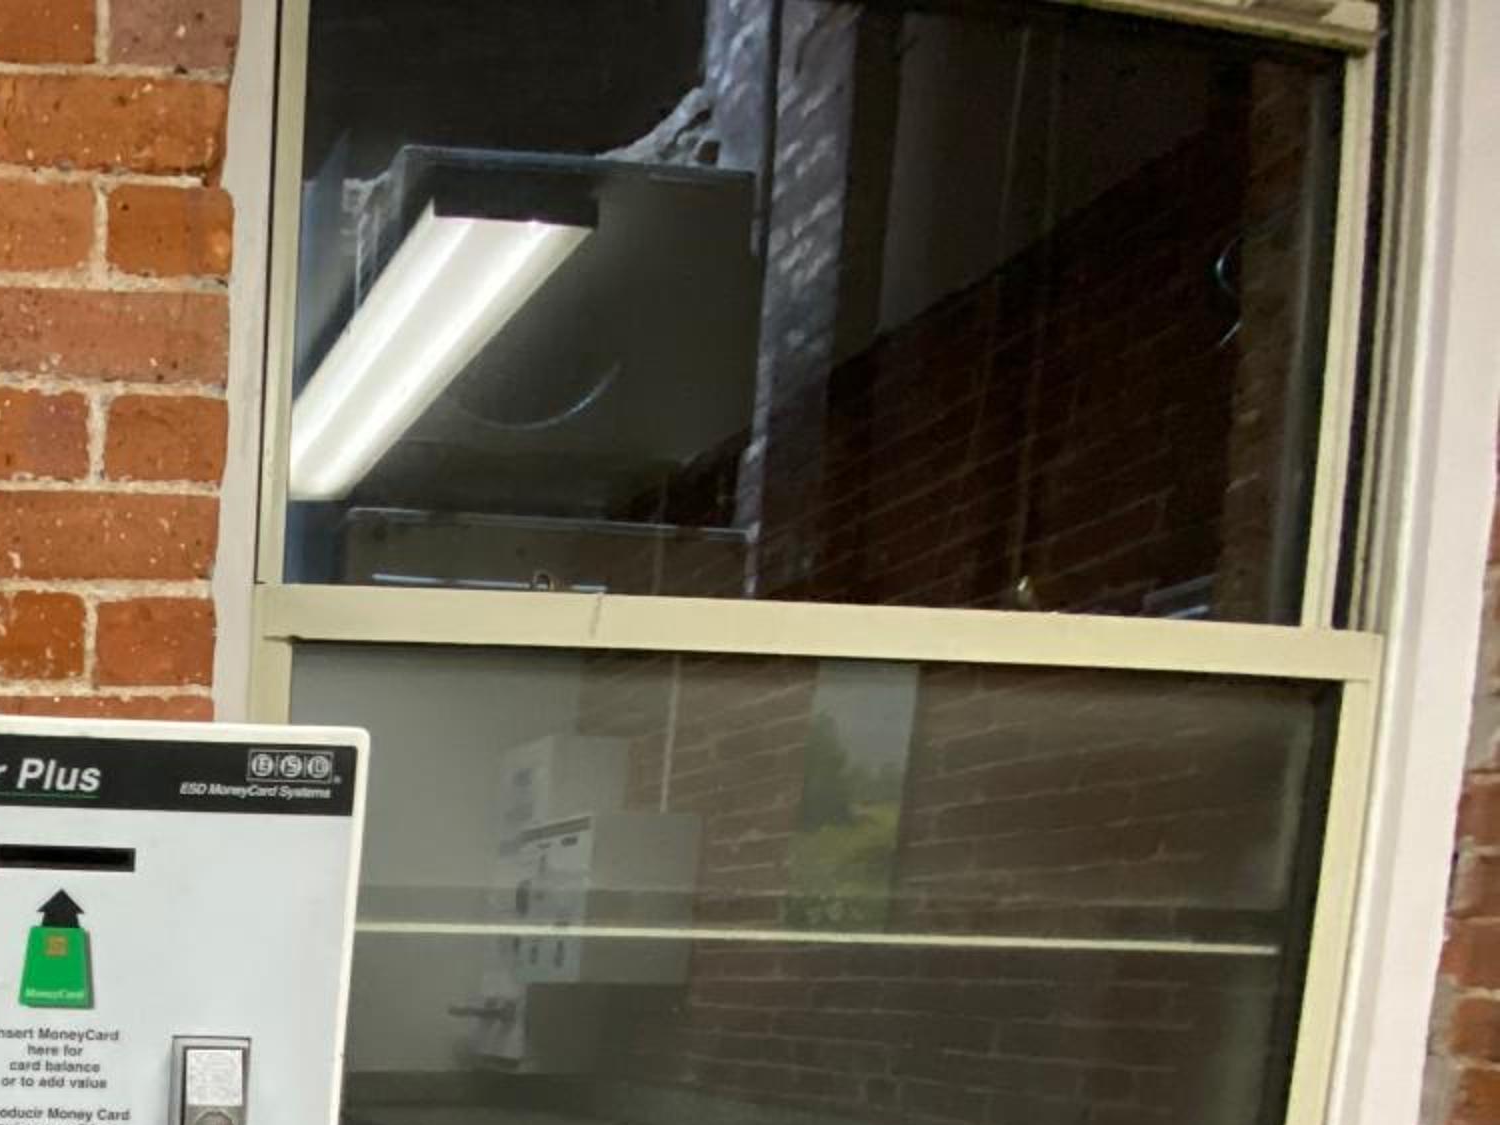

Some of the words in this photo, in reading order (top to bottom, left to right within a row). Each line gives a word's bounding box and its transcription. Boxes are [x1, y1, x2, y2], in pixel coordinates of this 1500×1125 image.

[16, 757, 101, 792] Plus
[180, 781, 207, 796] ESD
[208, 783, 278, 799] MoneyCard
[278, 785, 333, 801] Systems
[38, 1028, 120, 1042] MoneyCard
[27, 1044, 58, 1056] here
[63, 1045, 83, 1056] for
[9, 1060, 40, 1072] card
[45, 1061, 101, 1073] balance
[1, 1077, 16, 1087] or
[20, 1076, 34, 1087] to
[39, 1077, 65, 1088] add
[69, 1078, 107, 1089] value
[48, 1108, 92, 1122] Money
[97, 1109, 131, 1121] Card
